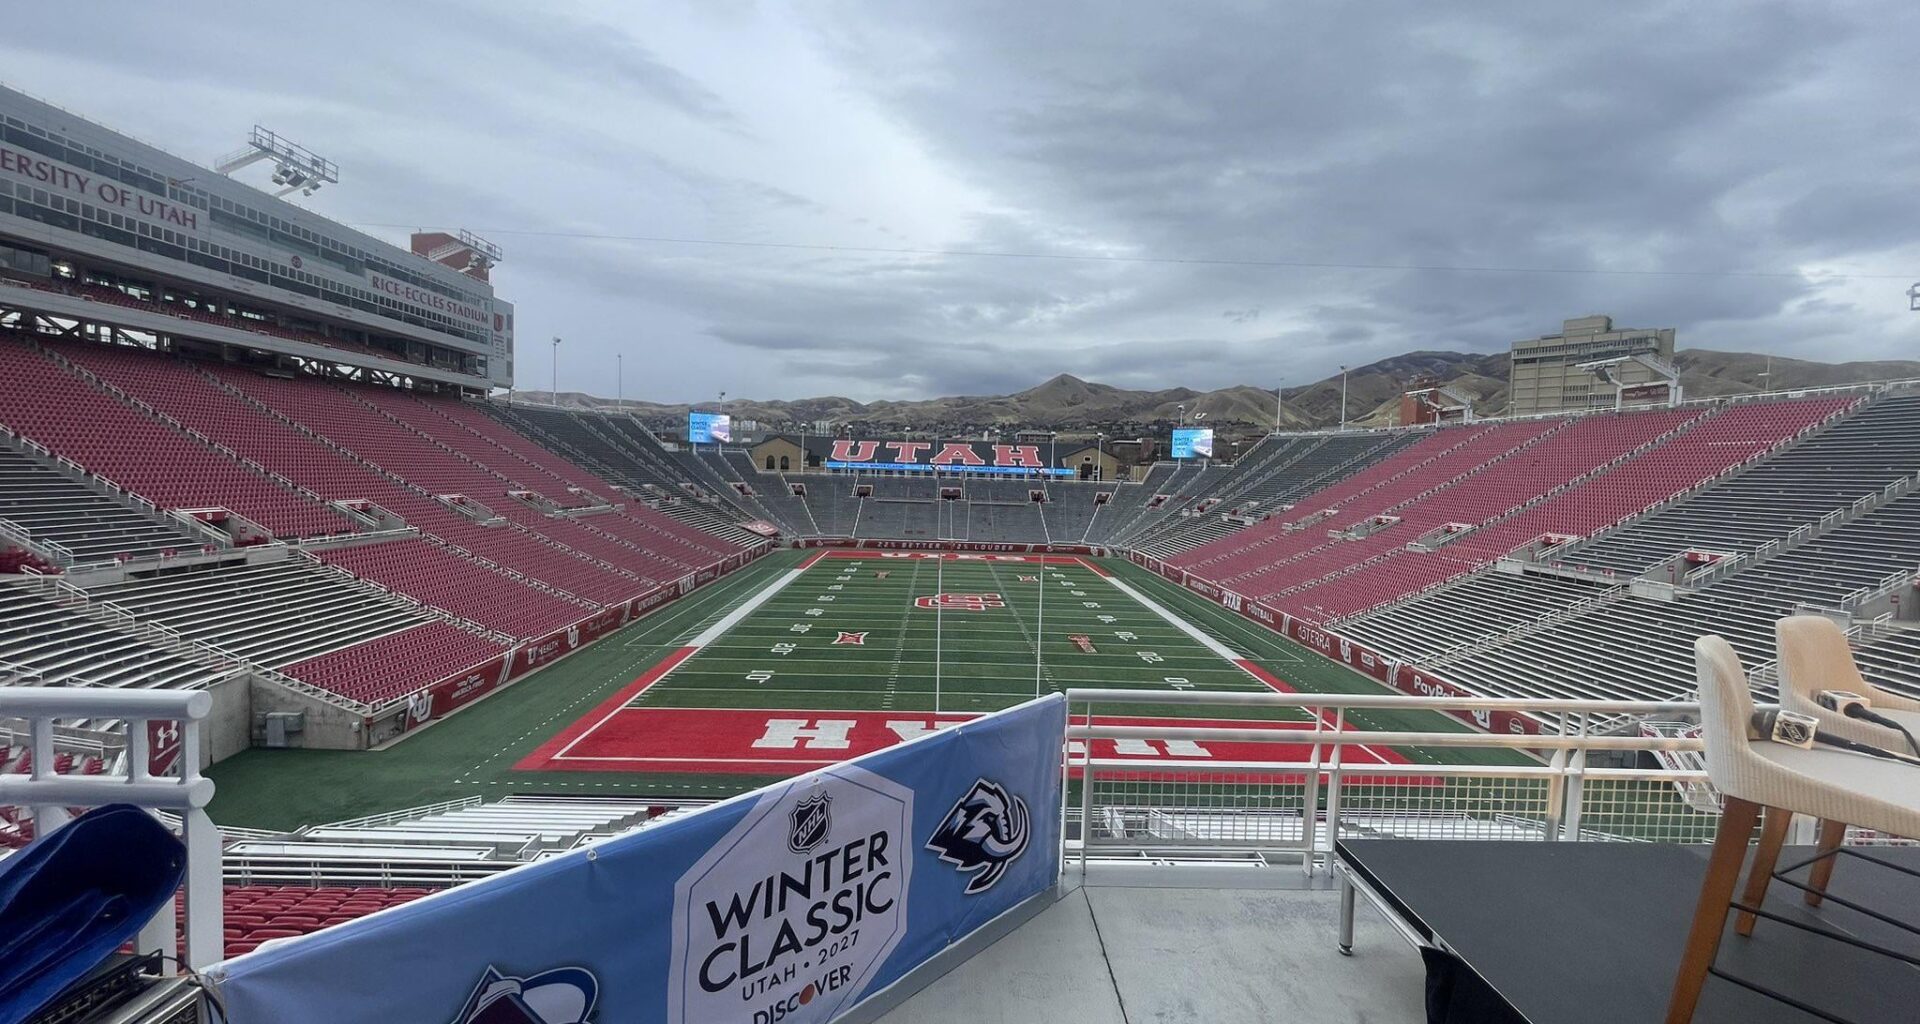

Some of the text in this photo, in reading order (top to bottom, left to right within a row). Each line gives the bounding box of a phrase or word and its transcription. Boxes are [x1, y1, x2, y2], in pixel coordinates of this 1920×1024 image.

[98, 183, 131, 207] OF
[139, 195, 197, 230] UTAH
[372, 276, 489, 323] RICE-ECCLES STADIUM
[831, 440, 1044, 467] UTAH
[799, 808, 825, 842] NHL
[706, 831, 889, 939] WINTER
[698, 871, 894, 993] CLASSIC
[742, 929, 859, 1002] UTAH 2027
